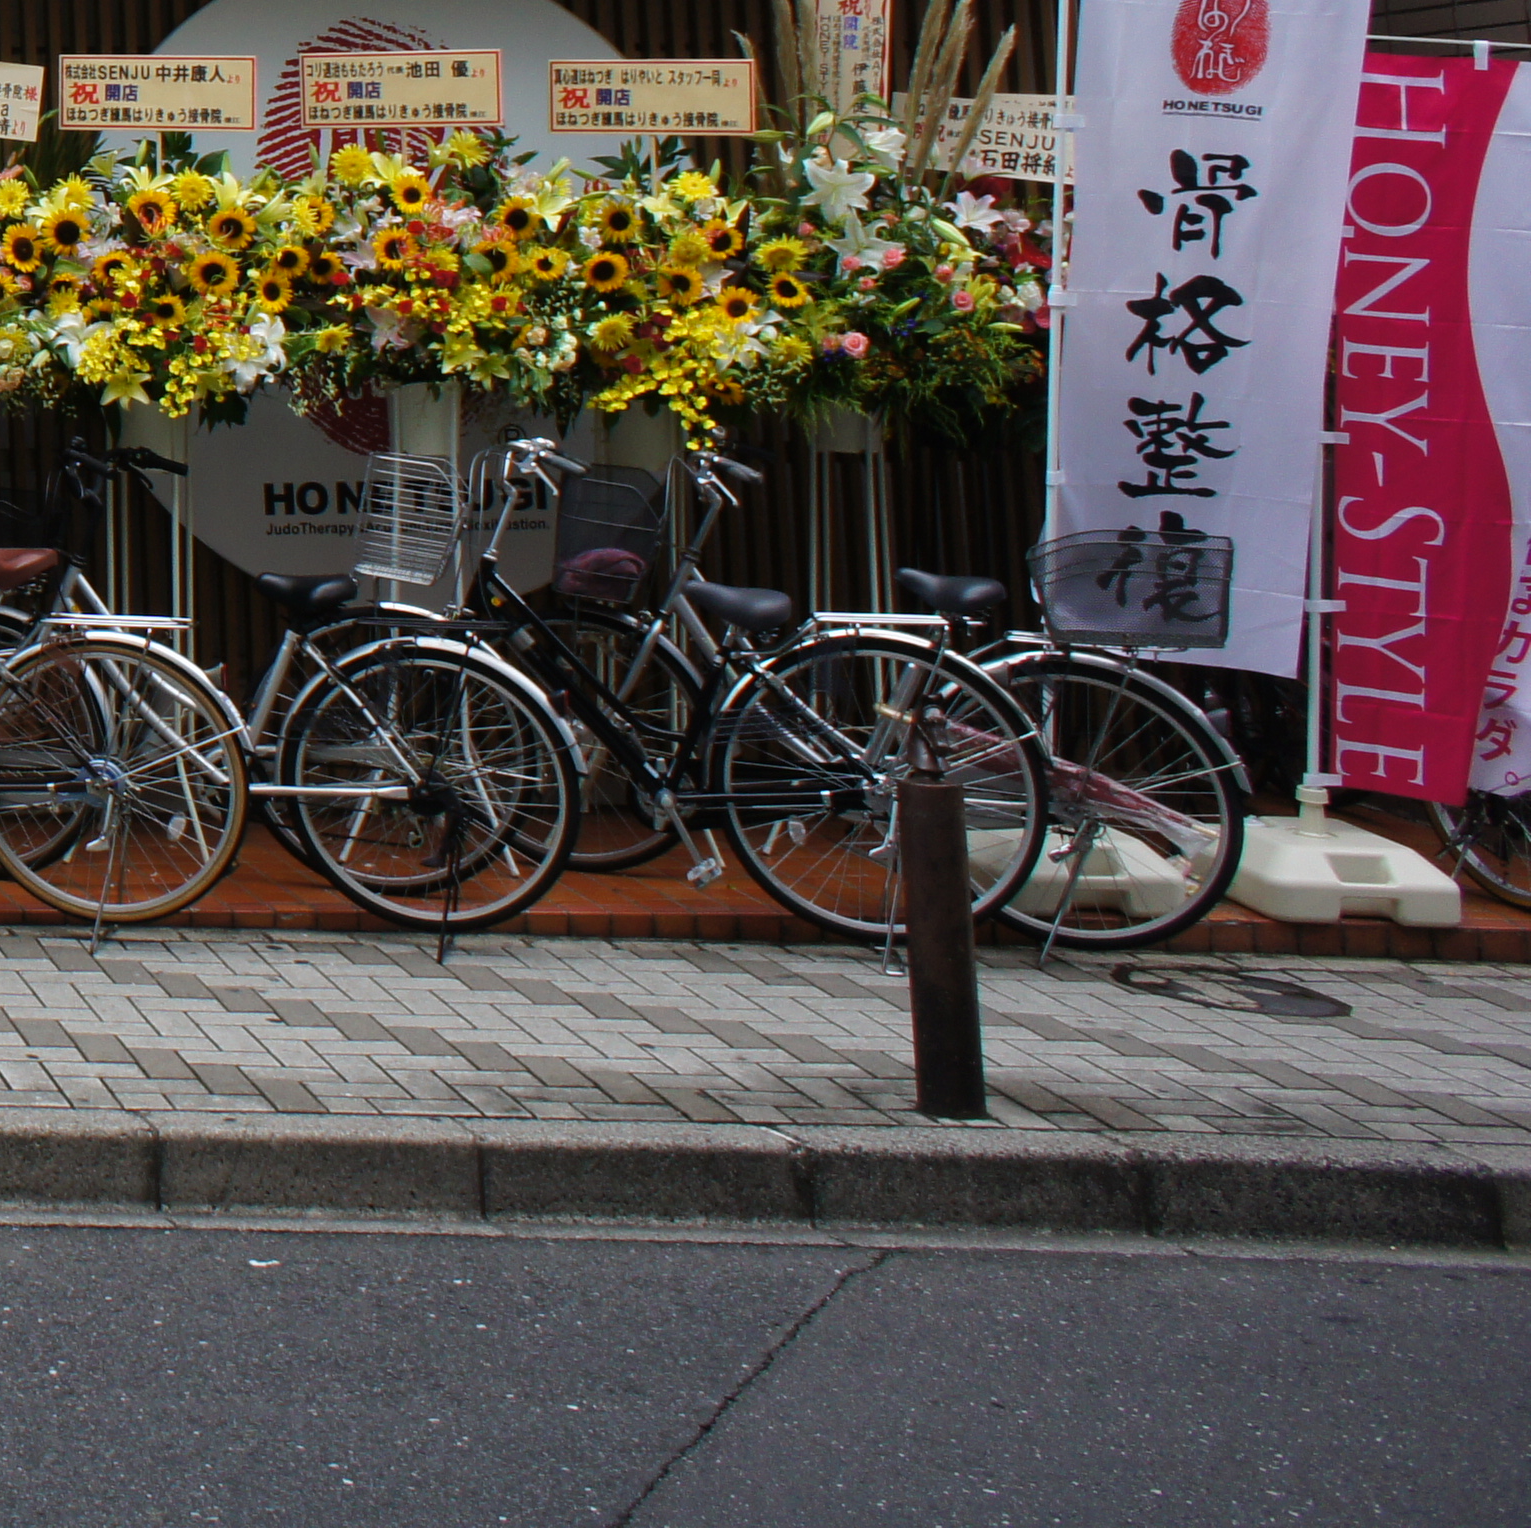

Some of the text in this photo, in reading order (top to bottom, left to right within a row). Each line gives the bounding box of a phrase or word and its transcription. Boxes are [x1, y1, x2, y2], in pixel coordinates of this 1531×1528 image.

[68, 82, 138, 104] 祝 開店
[311, 81, 381, 103] 祝 開店
[558, 87, 630, 109] 祝 開店
[979, 130, 1056, 151] SENJU
[1336, 69, 1446, 789] HONEY-STYLE
